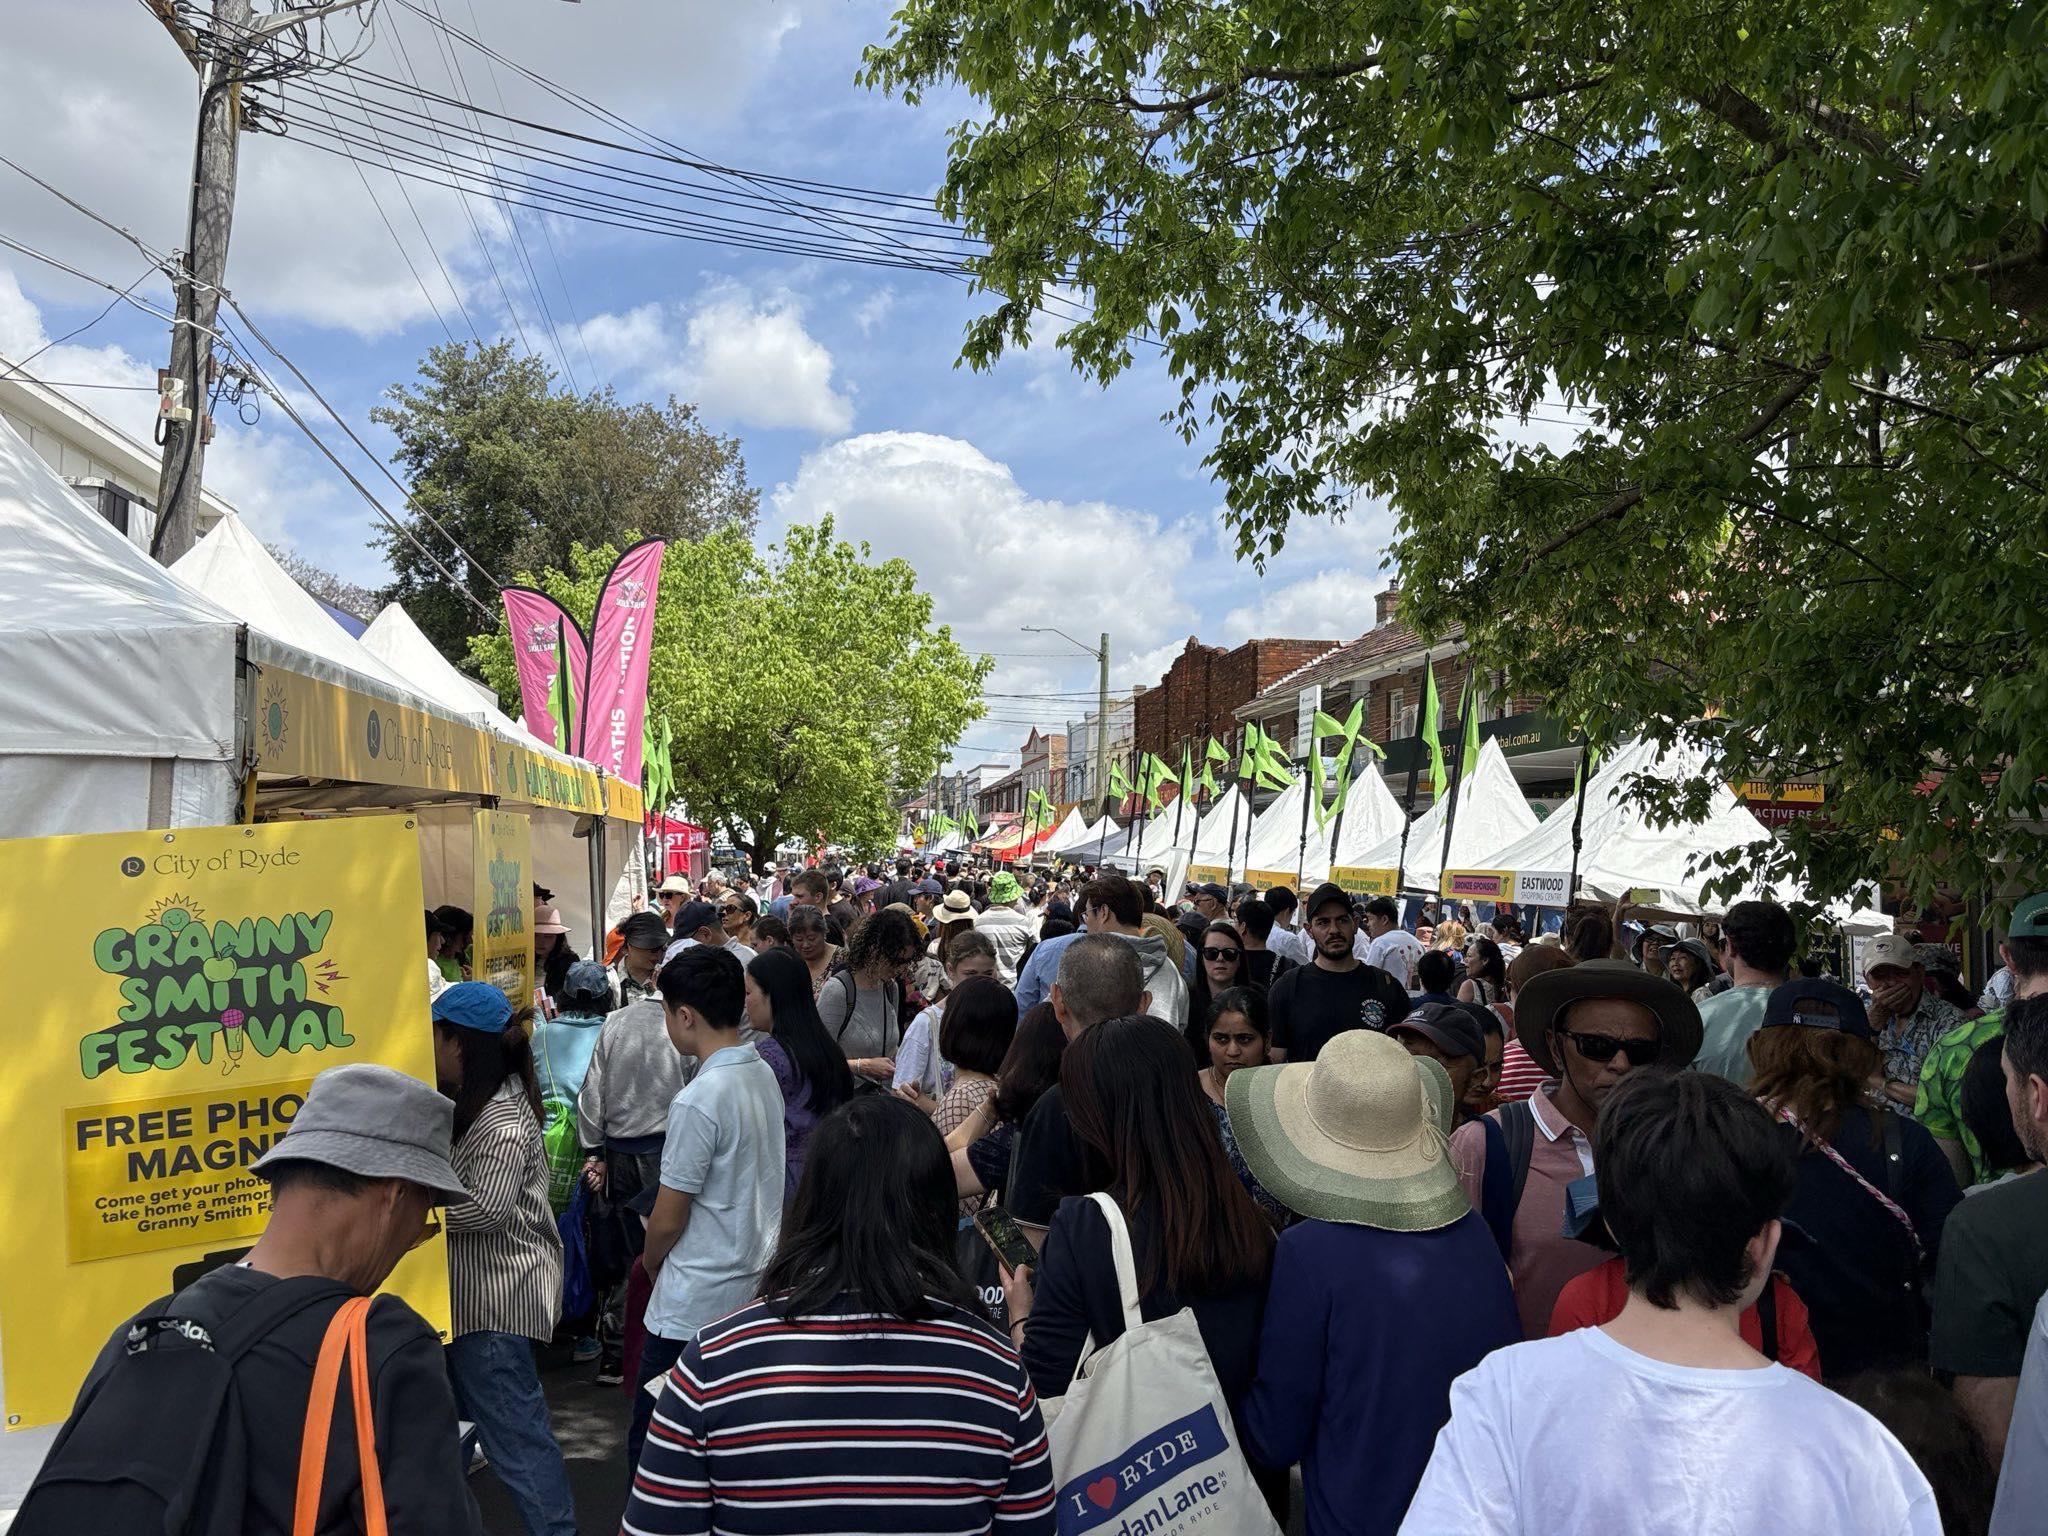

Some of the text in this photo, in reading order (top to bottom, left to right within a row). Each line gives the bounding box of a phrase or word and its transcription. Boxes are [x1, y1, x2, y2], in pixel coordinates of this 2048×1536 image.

[384, 718, 408, 776] City
[410, 723, 423, 766] of
[426, 724, 452, 783] Ryde
[1753, 808, 1795, 819] ACTIVE
[153, 853, 200, 879] City
[206, 851, 233, 872] of
[239, 846, 301, 874] Ryde
[1454, 880, 1498, 891] BRONZE SPONSOR
[1521, 877, 1564, 891] EASTWOOD
[1521, 890, 1562, 902] SHOPPING CENTRE
[94, 909, 334, 973] GRANNY
[485, 953, 526, 974] FREE PHOTO
[117, 958, 308, 1023] SMITH
[79, 1005, 356, 1080] FESTIVAL
[76, 1092, 310, 1151] FREE PHO
[95, 1193, 145, 1210] Come
[151, 1187, 178, 1205] get
[182, 1182, 220, 1199] your
[101, 1190, 272, 1224] take home a memor
[137, 1214, 199, 1233] Granny
[204, 1205, 252, 1223] Smith
[1070, 1429, 1198, 1518] I RYDE
[1190, 1501, 1220, 1525] RYDE
